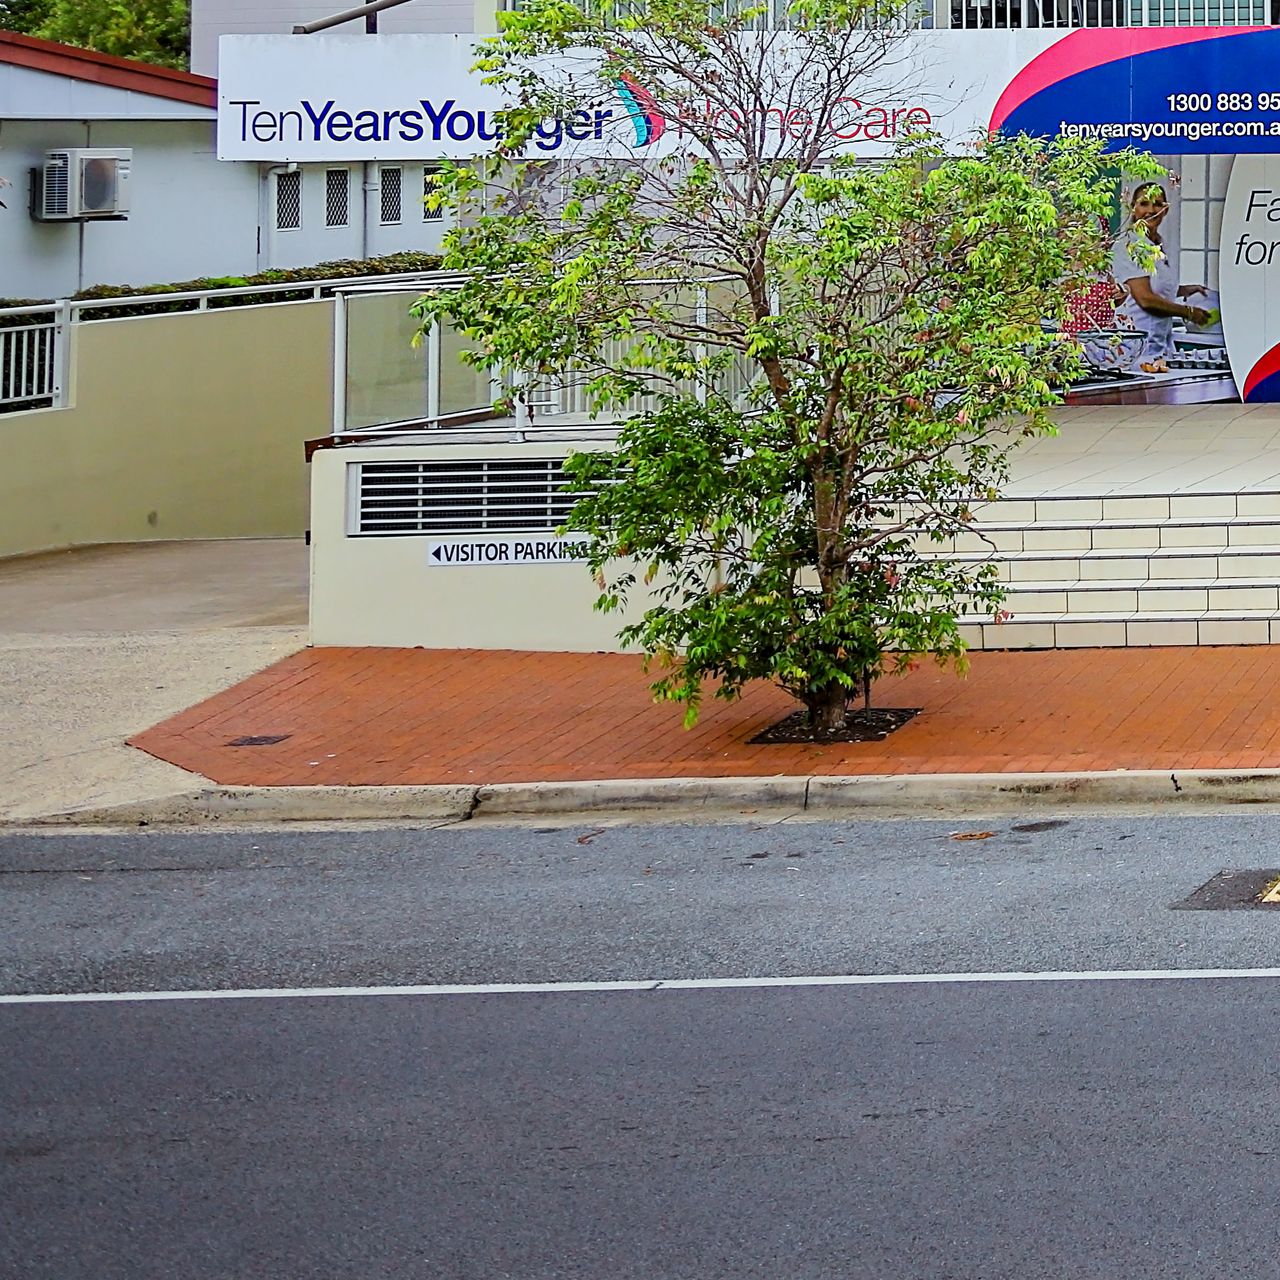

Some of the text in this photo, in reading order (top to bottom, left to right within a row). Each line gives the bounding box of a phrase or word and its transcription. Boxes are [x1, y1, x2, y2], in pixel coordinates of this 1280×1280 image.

[828, 96, 932, 140] Care
[1166, 93, 1212, 112] 1300
[1216, 92, 1253, 112] 883
[228, 99, 613, 151] TenYearsYouger
[443, 540, 588, 562] VISITOR PARKING
